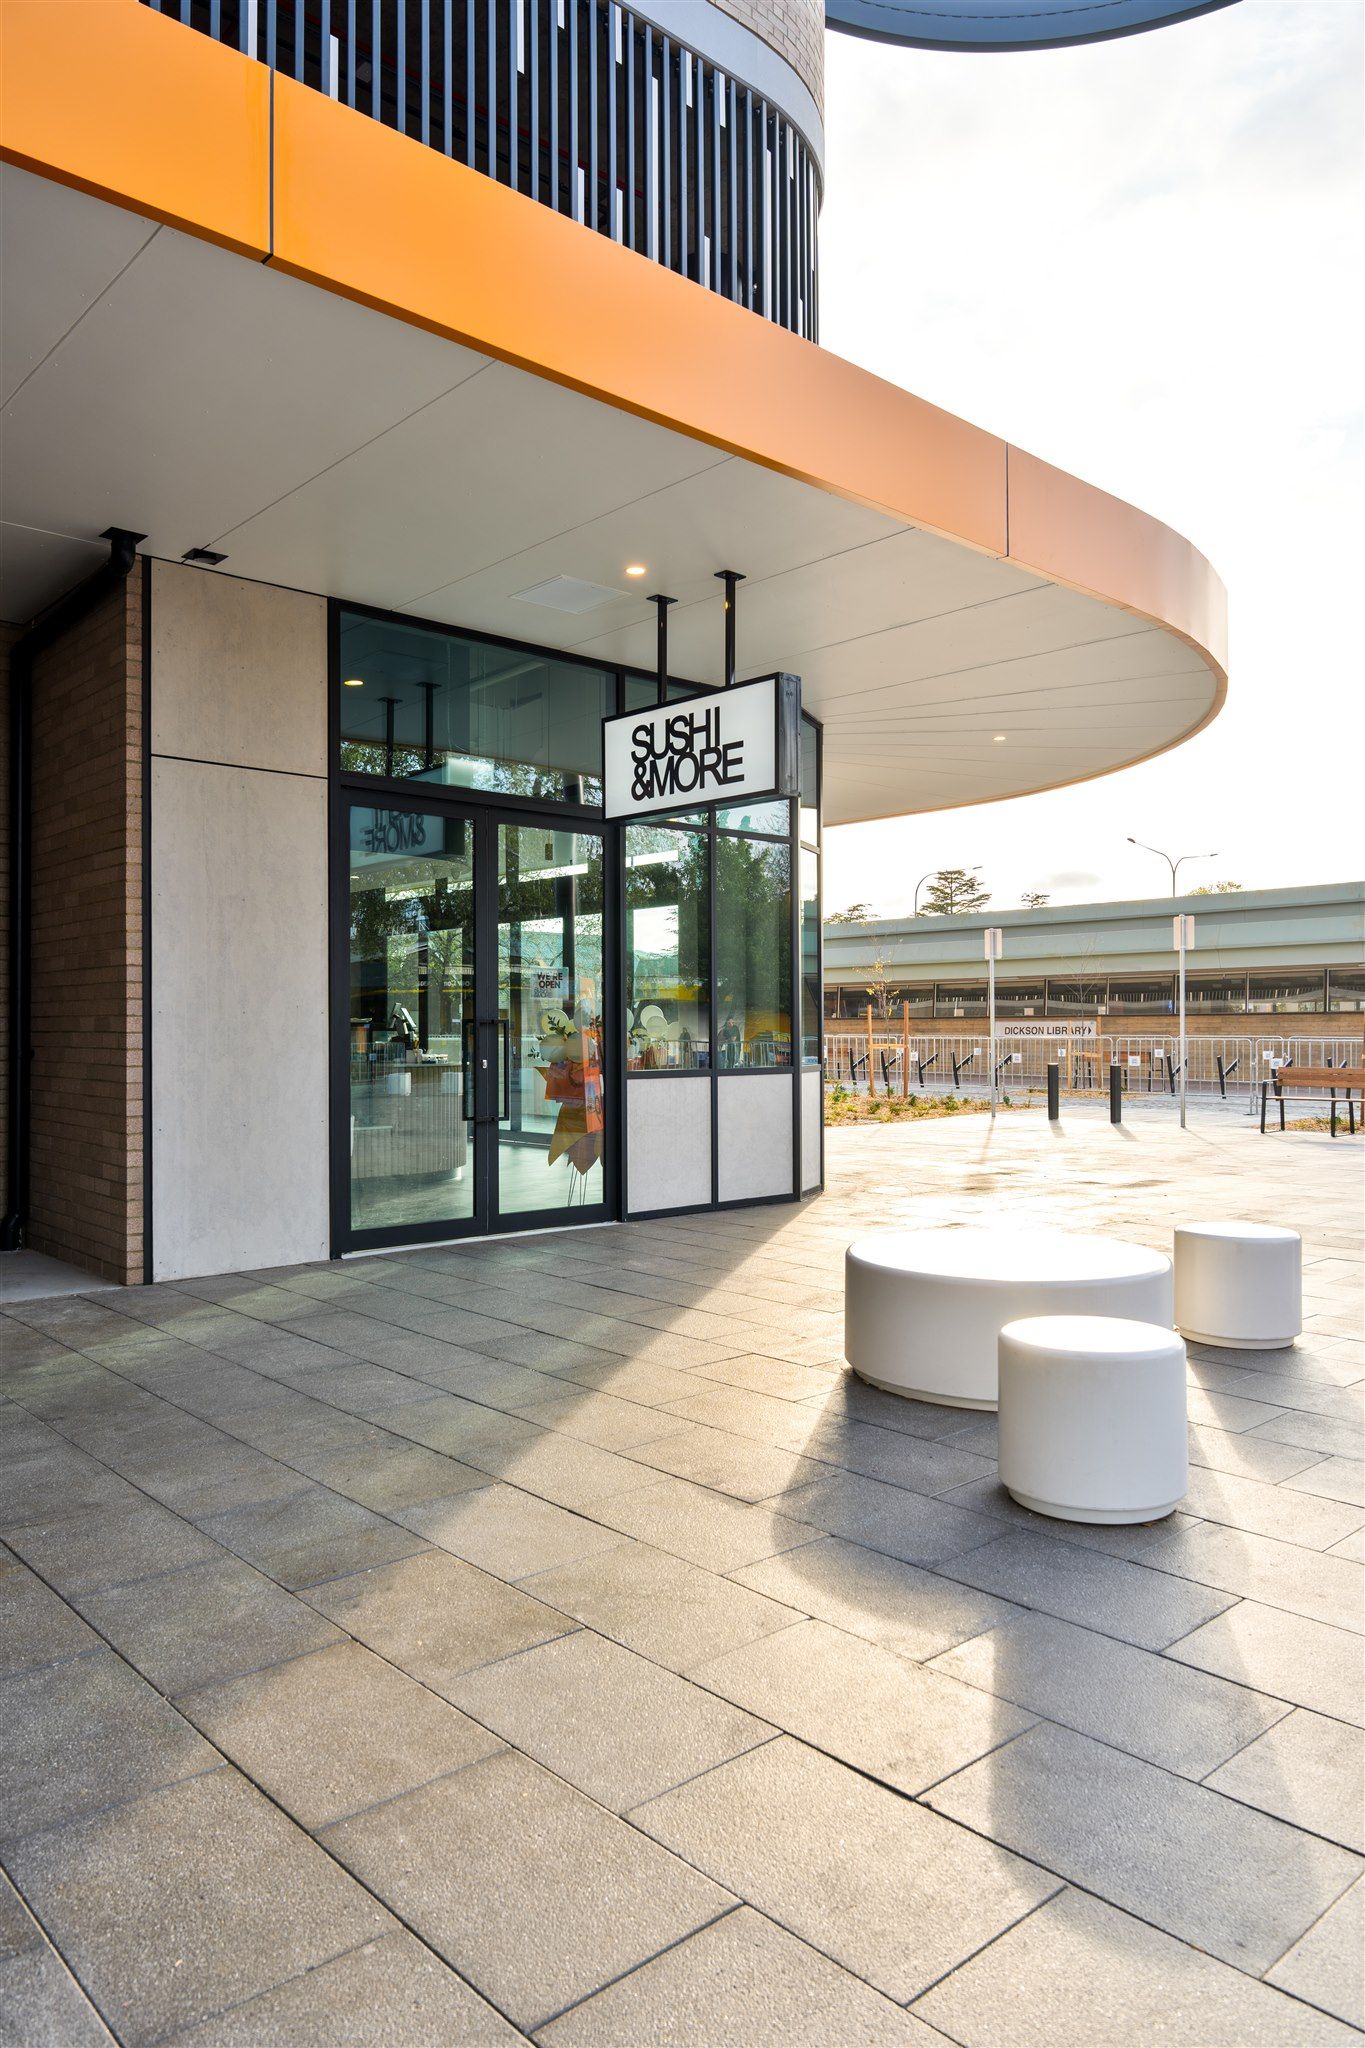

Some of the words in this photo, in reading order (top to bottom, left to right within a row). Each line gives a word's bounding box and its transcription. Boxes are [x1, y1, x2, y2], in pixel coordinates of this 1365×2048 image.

[631, 706, 720, 764] SUSHI
[631, 740, 744, 801] &MORE
[537, 972, 563, 980] WERE
[538, 980, 561, 989] OPEN
[1004, 1026, 1044, 1035] DICKSON
